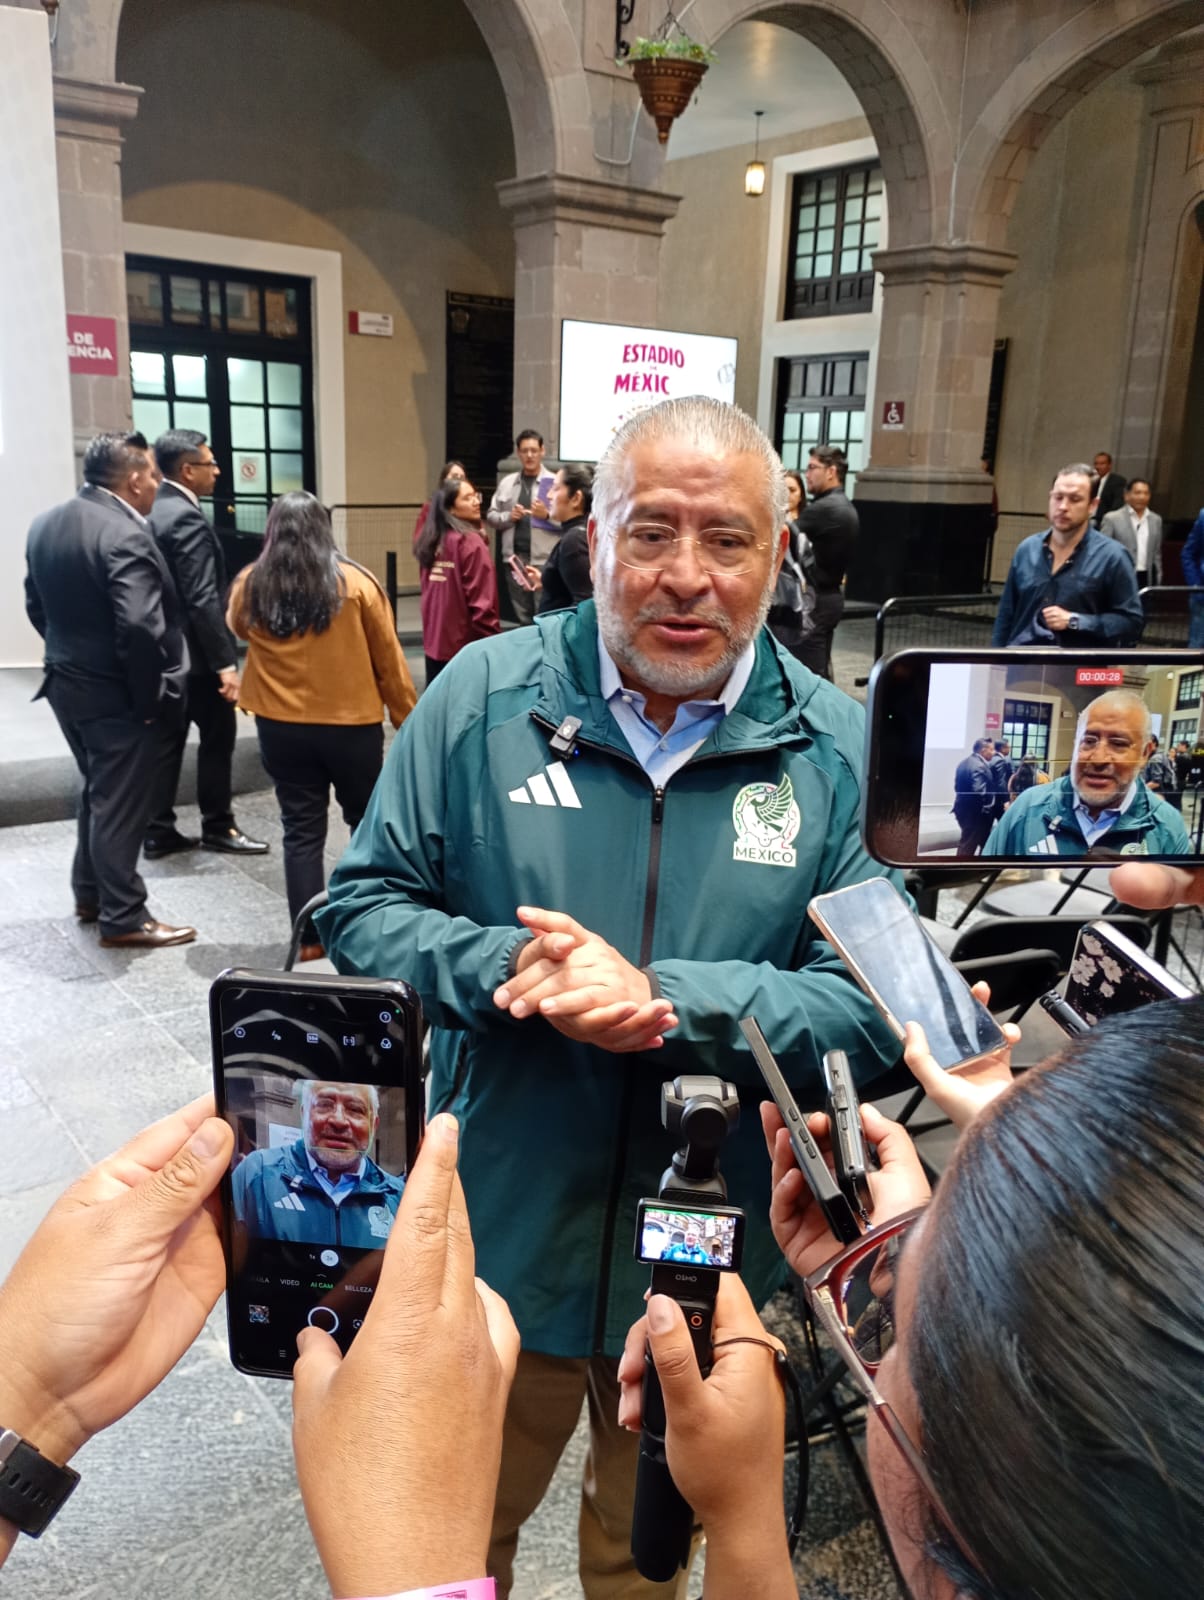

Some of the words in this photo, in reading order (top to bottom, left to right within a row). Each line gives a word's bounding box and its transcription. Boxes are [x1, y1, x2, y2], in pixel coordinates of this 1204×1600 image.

[73, 331, 94, 346] DE
[622, 343, 685, 369] ESTADIO
[1079, 672, 1121, 681] 00:00:28
[735, 846, 793, 863] MEXICO
[344, 1284, 373, 1293] BELLEZA
